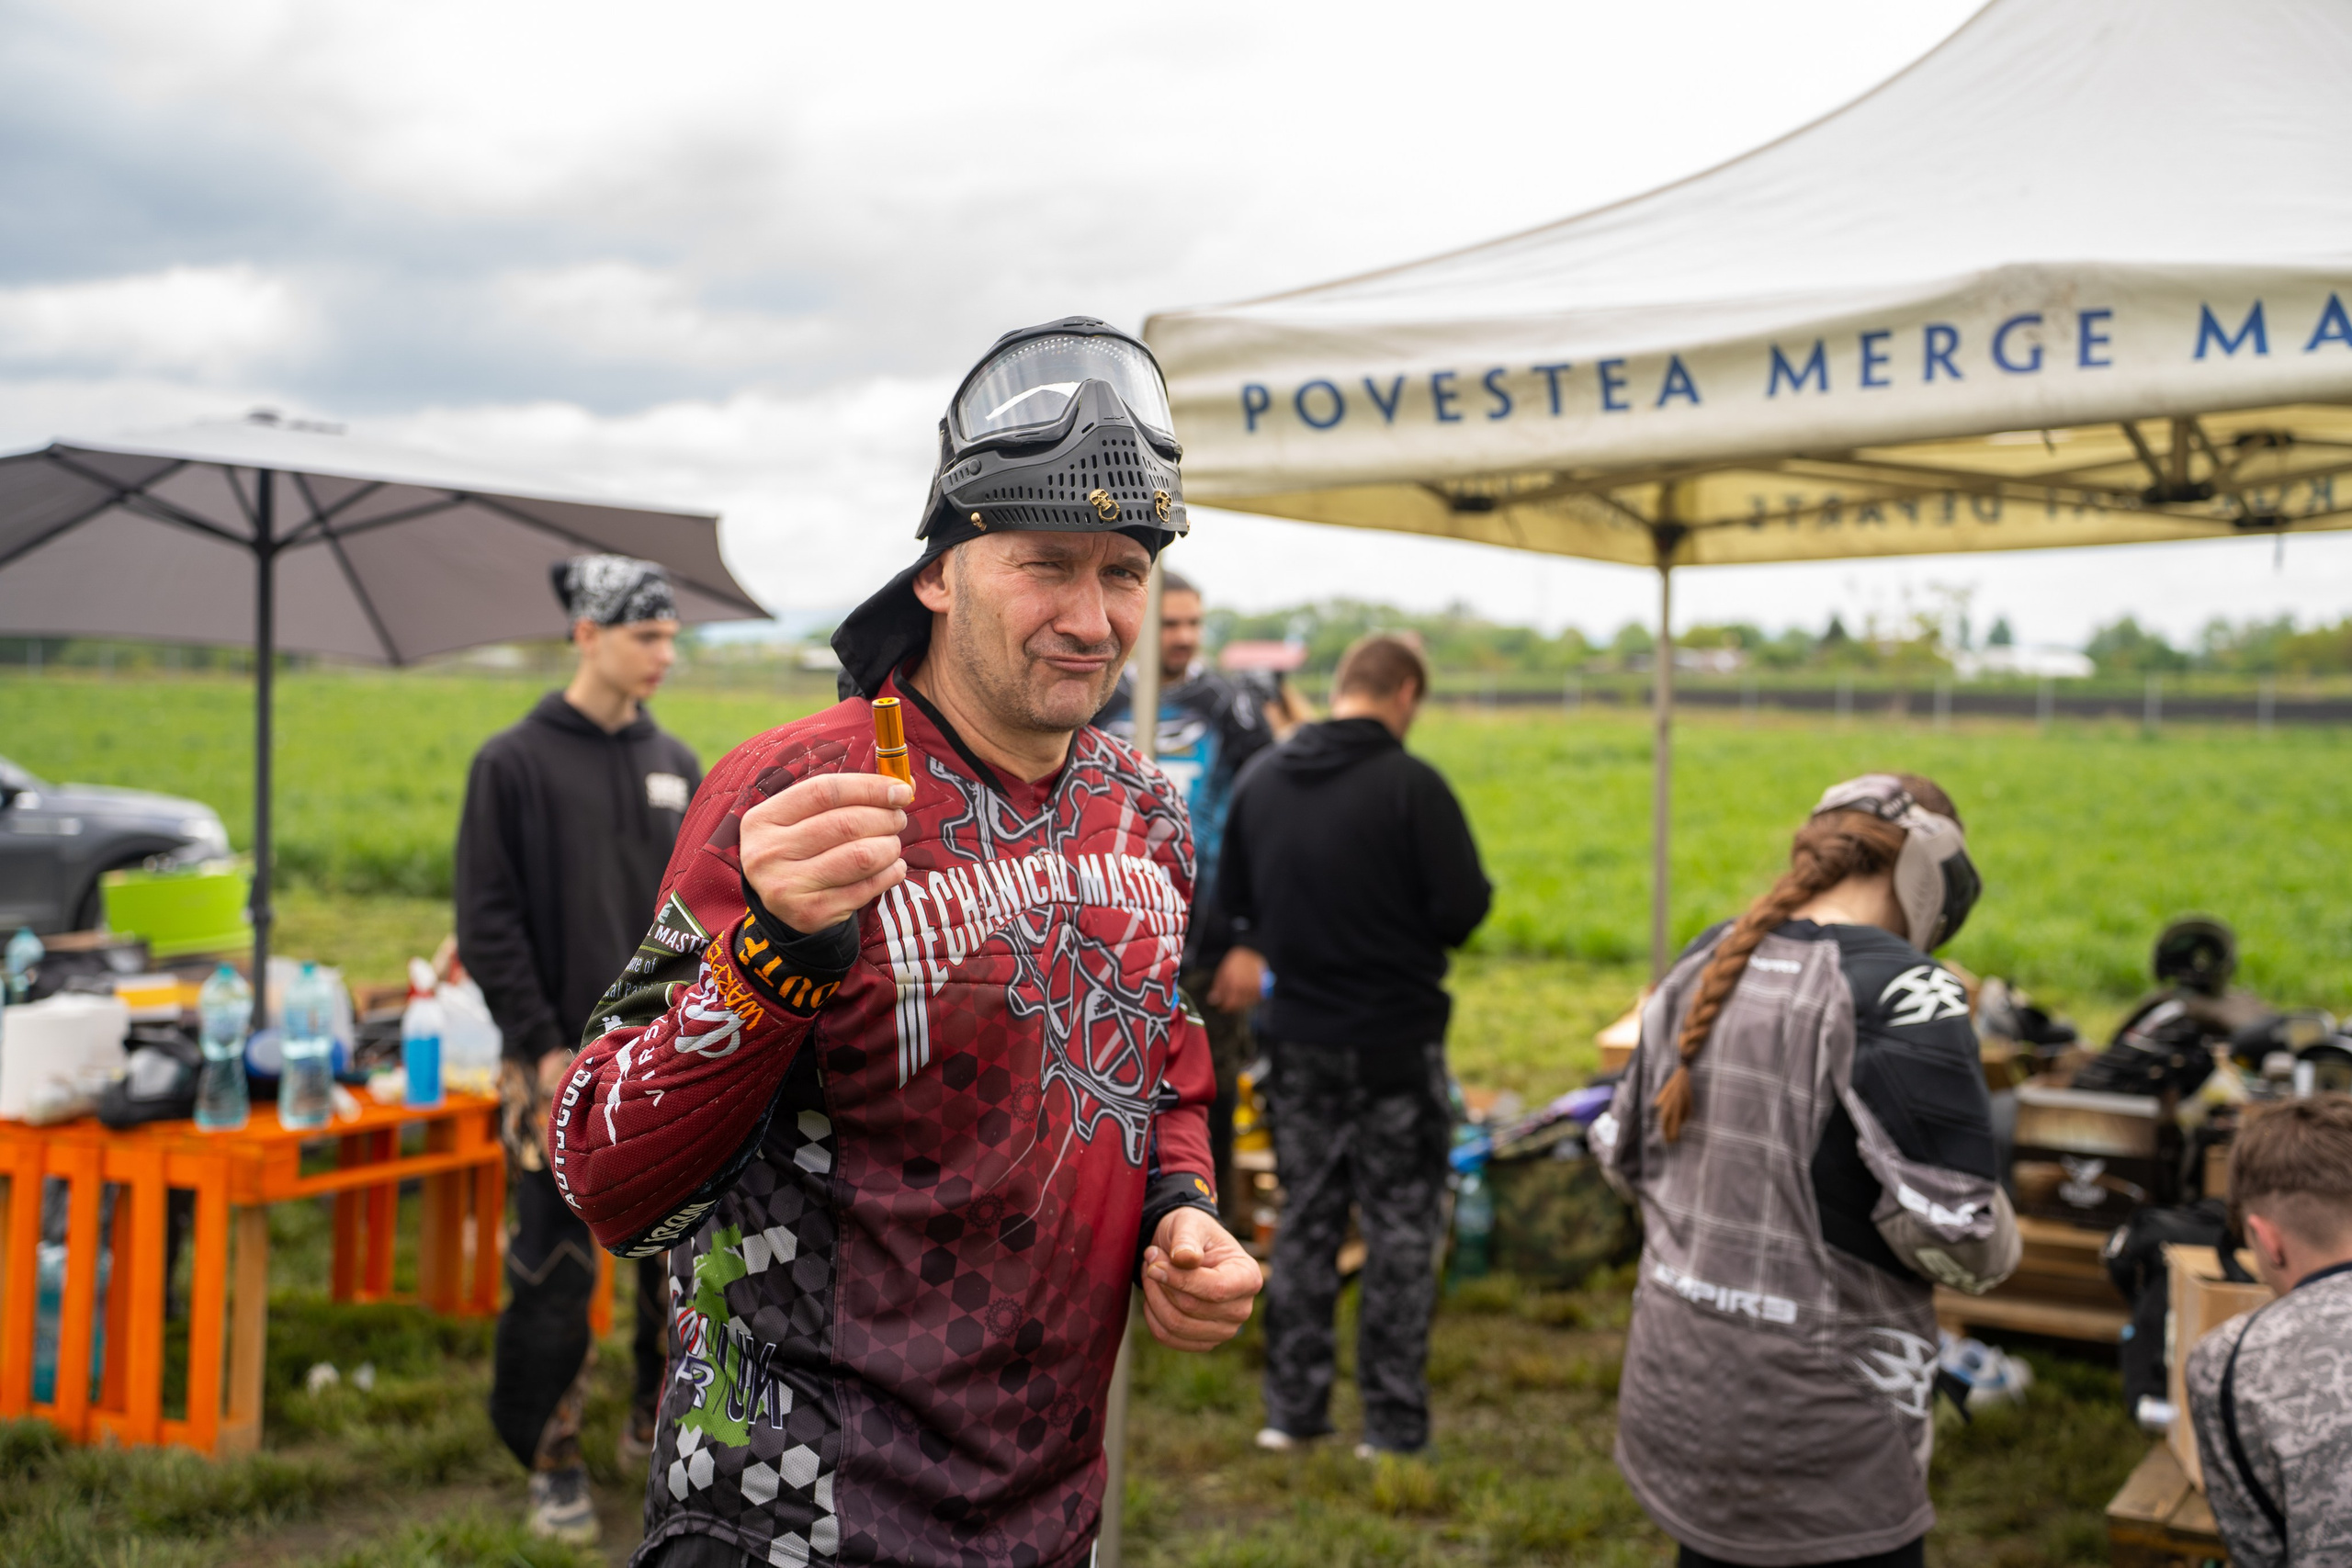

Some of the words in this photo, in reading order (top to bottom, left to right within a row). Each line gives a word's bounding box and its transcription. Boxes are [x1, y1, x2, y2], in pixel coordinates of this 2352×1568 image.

[1242, 351, 1702, 434] POVESTEA
[1766, 309, 2115, 399] MERGE
[2192, 288, 2352, 361] MA
[644, 956, 658, 974] of
[877, 854, 1079, 1090] MECHANICAL
